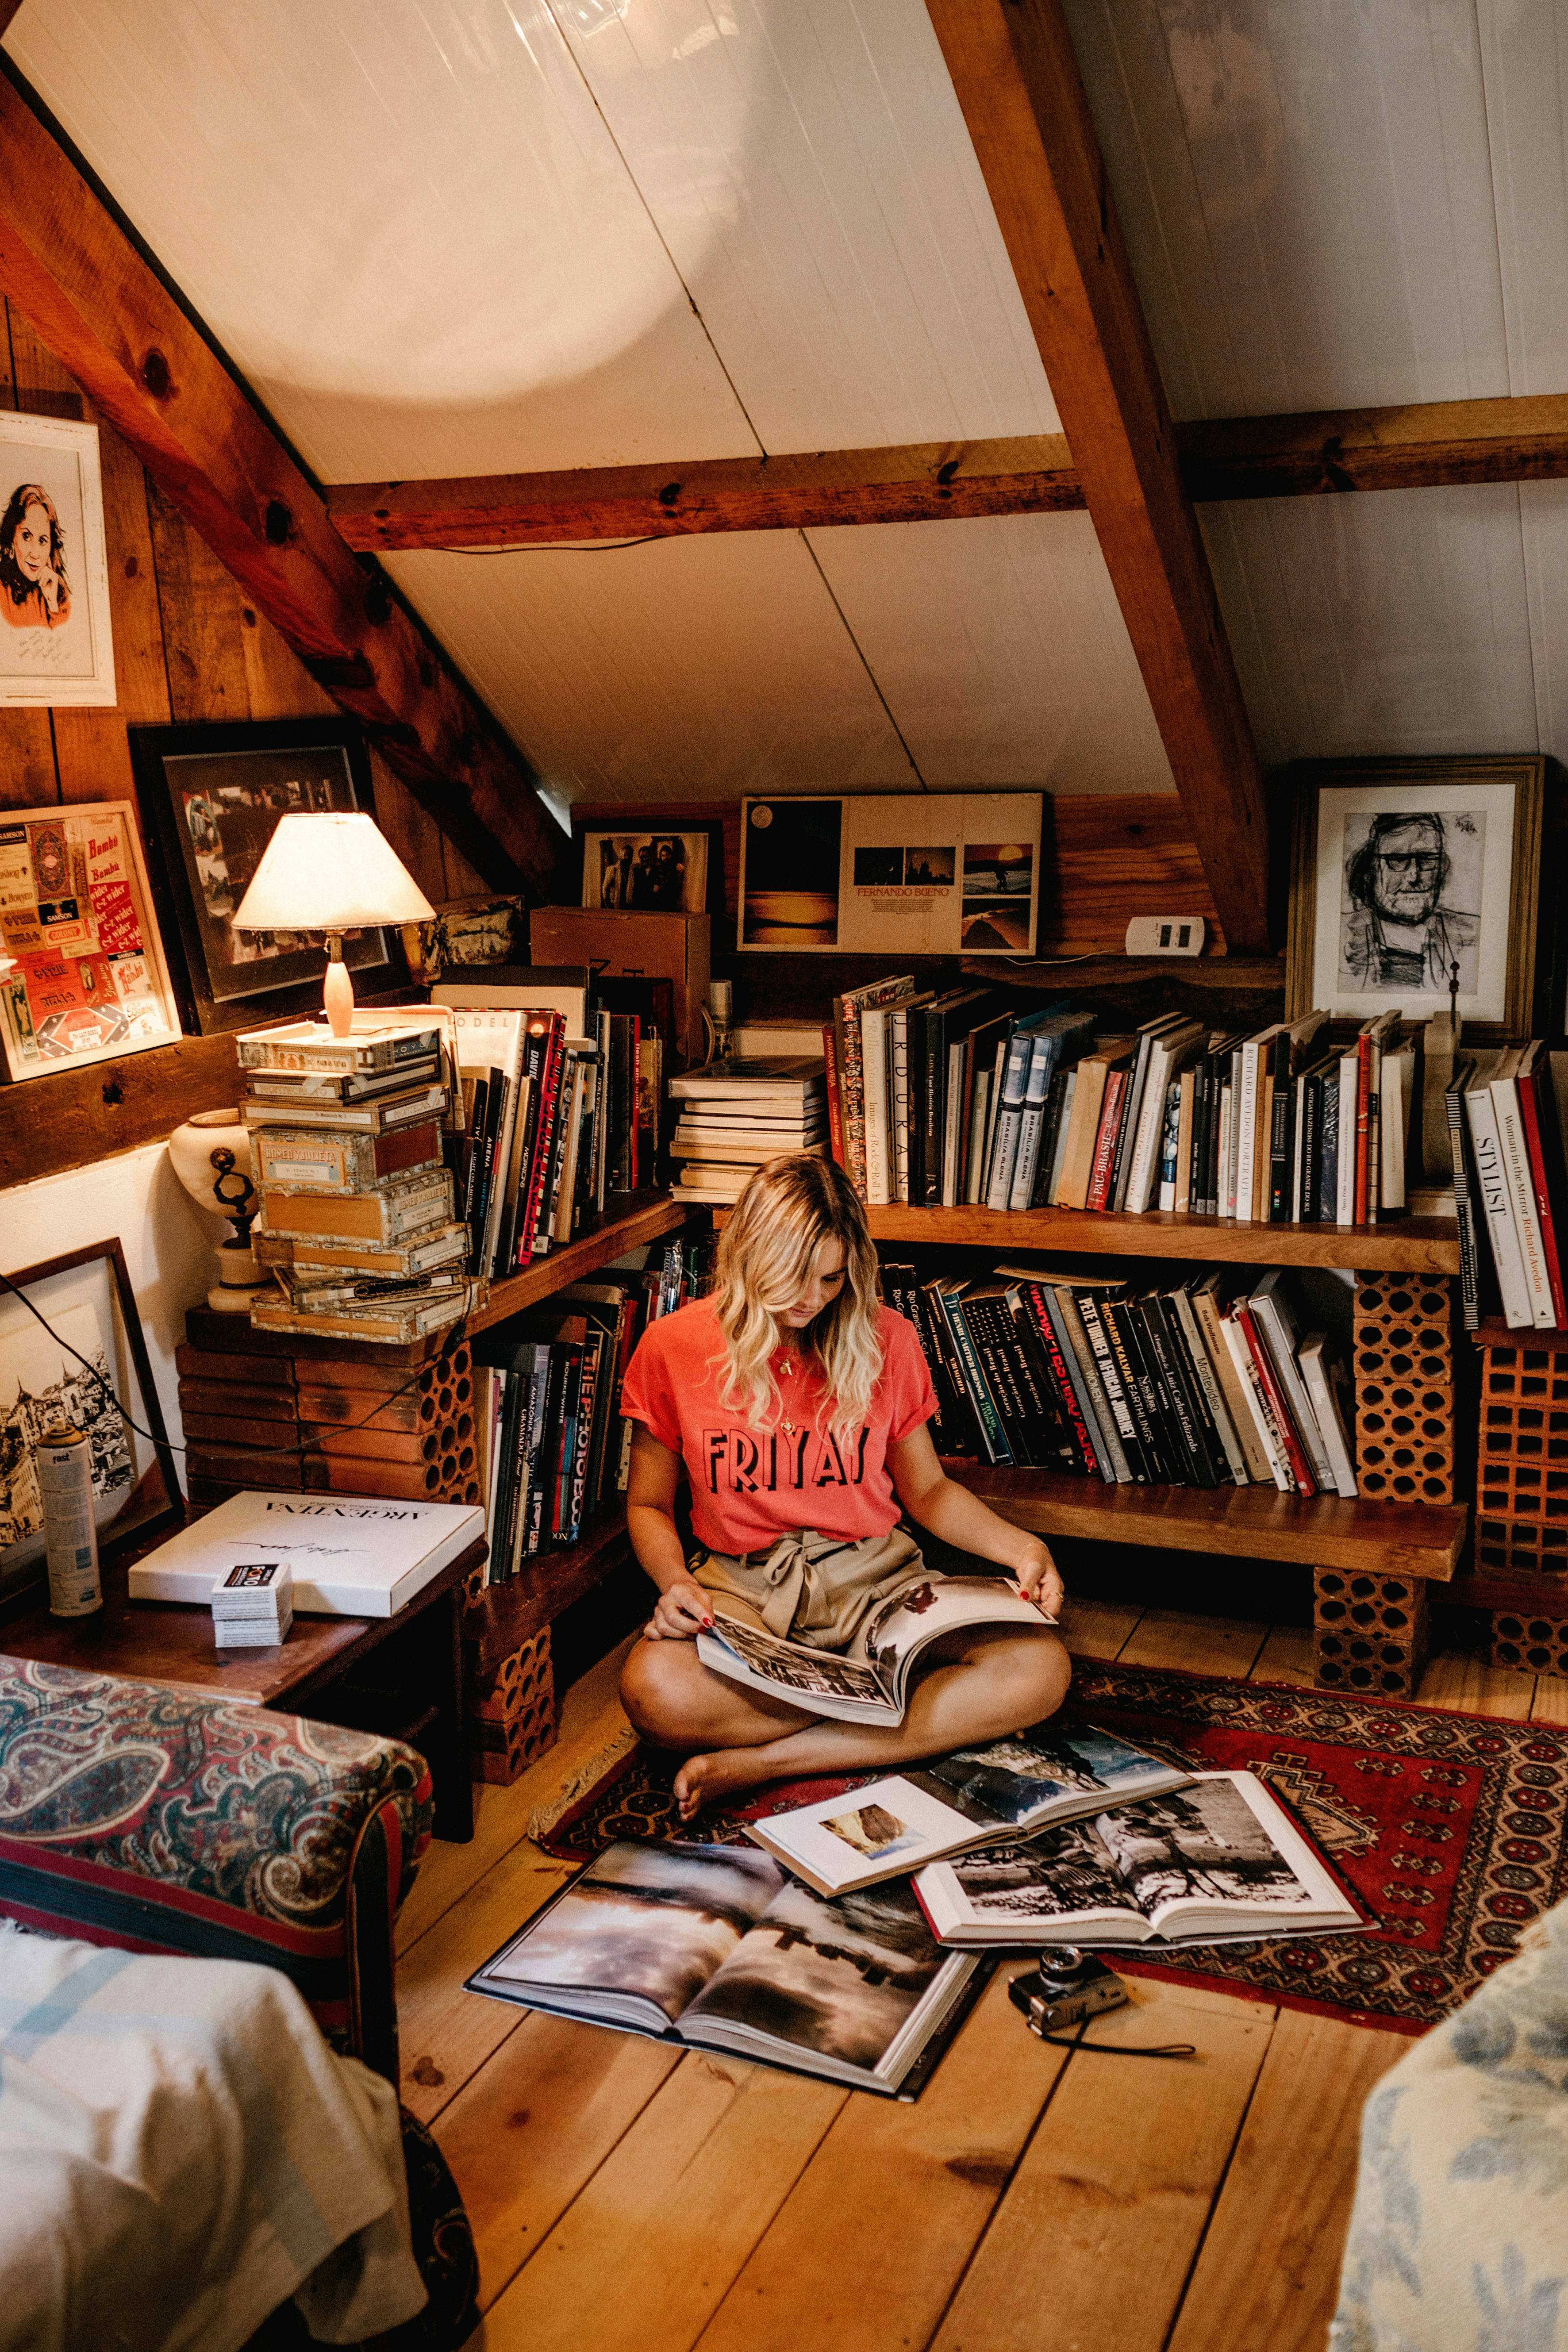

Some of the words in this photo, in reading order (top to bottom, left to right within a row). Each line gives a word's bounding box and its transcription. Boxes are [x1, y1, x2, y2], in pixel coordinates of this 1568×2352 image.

[857, 888, 912, 896] FERNANDO
[915, 888, 949, 896] BUENO
[47, 912, 72, 922] SAMSON
[845, 1003, 853, 1020] LIFE
[826, 1035, 835, 1068] HAVANA
[846, 1024, 857, 1068] PLATINUM
[1125, 1072, 1135, 1103] ARQUITETURA
[1245, 1048, 1254, 1095] RICHARD
[850, 1072, 861, 1131] ANNIVERSARY
[869, 1102, 878, 1129] Images
[1002, 1116, 1012, 1154] BRASÍLIA
[1026, 1115, 1035, 1153] BRASÍLIA
[1137, 1111, 1149, 1150] PAISAGEM
[1504, 1115, 1517, 1152] Woman
[266, 1149, 293, 1159] ROMEO
[302, 1151, 336, 1162] JULIETA
[853, 1134, 863, 1186] COLLECTION
[871, 1140, 880, 1160] Rock
[1093, 1134, 1112, 1195] PAU-BRASIL
[1114, 1148, 1123, 1170] CATARINA
[1306, 1144, 1312, 1153] DO
[1511, 1153, 1521, 1164] in
[470, 1172, 475, 1182] ON
[520, 1146, 529, 1188] MIGRATIONS
[872, 1172, 880, 1188] Roll
[1129, 1152, 1141, 1197] BRASILEIRA
[1241, 1142, 1250, 1196] PORTRAITS
[1476, 1137, 1507, 1216] STYLIST
[1514, 1166, 1524, 1182] the
[1304, 1191, 1310, 1201] DO
[1517, 1184, 1530, 1215] Mirror
[1522, 1218, 1537, 1257] Richard
[1530, 1258, 1543, 1293] Avedon
[907, 1290, 915, 1304] Rio
[1078, 1297, 1098, 1321] PETE
[910, 1304, 922, 1330] Grande
[1063, 1304, 1078, 1329] ANNIE
[1072, 1330, 1090, 1368] LEIBOVITZ
[1085, 1369, 1103, 1403] WOMEN
[1086, 1320, 1110, 1357] TURNER
[1205, 1322, 1221, 1355] Wolfenson
[952, 1312, 964, 1336] HENRI
[959, 1337, 975, 1368] CARTIER
[970, 1368, 986, 1400] BRESSON
[983, 1348, 997, 1371] Brasil
[996, 1349, 1011, 1372] Brasil
[1013, 1345, 1027, 1368] Brasil
[992, 1372, 1001, 1383] do
[1006, 1373, 1015, 1384] do
[1024, 1370, 1033, 1380] do
[1098, 1359, 1123, 1399] AFRICAN
[1100, 1302, 1121, 1345] RICHARD
[1114, 1346, 1134, 1384] KALVAR
[1127, 1384, 1154, 1444] EARTHLINGS
[1196, 1357, 1221, 1411] Montevideo
[559, 1361, 570, 1424] BOURKE-WHITE
[998, 1384, 1012, 1417] Coração
[1011, 1385, 1026, 1418] Coração
[1029, 1381, 1044, 1414] Coração
[1110, 1399, 1137, 1440] JOURNEY
[1165, 1372, 1179, 1389] Luiz
[1172, 1390, 1187, 1417] Carlos
[1180, 1416, 1199, 1453] Felizardo
[518, 1408, 527, 1455] GRAMADO
[266, 1502, 429, 1520] ARGENTINA
